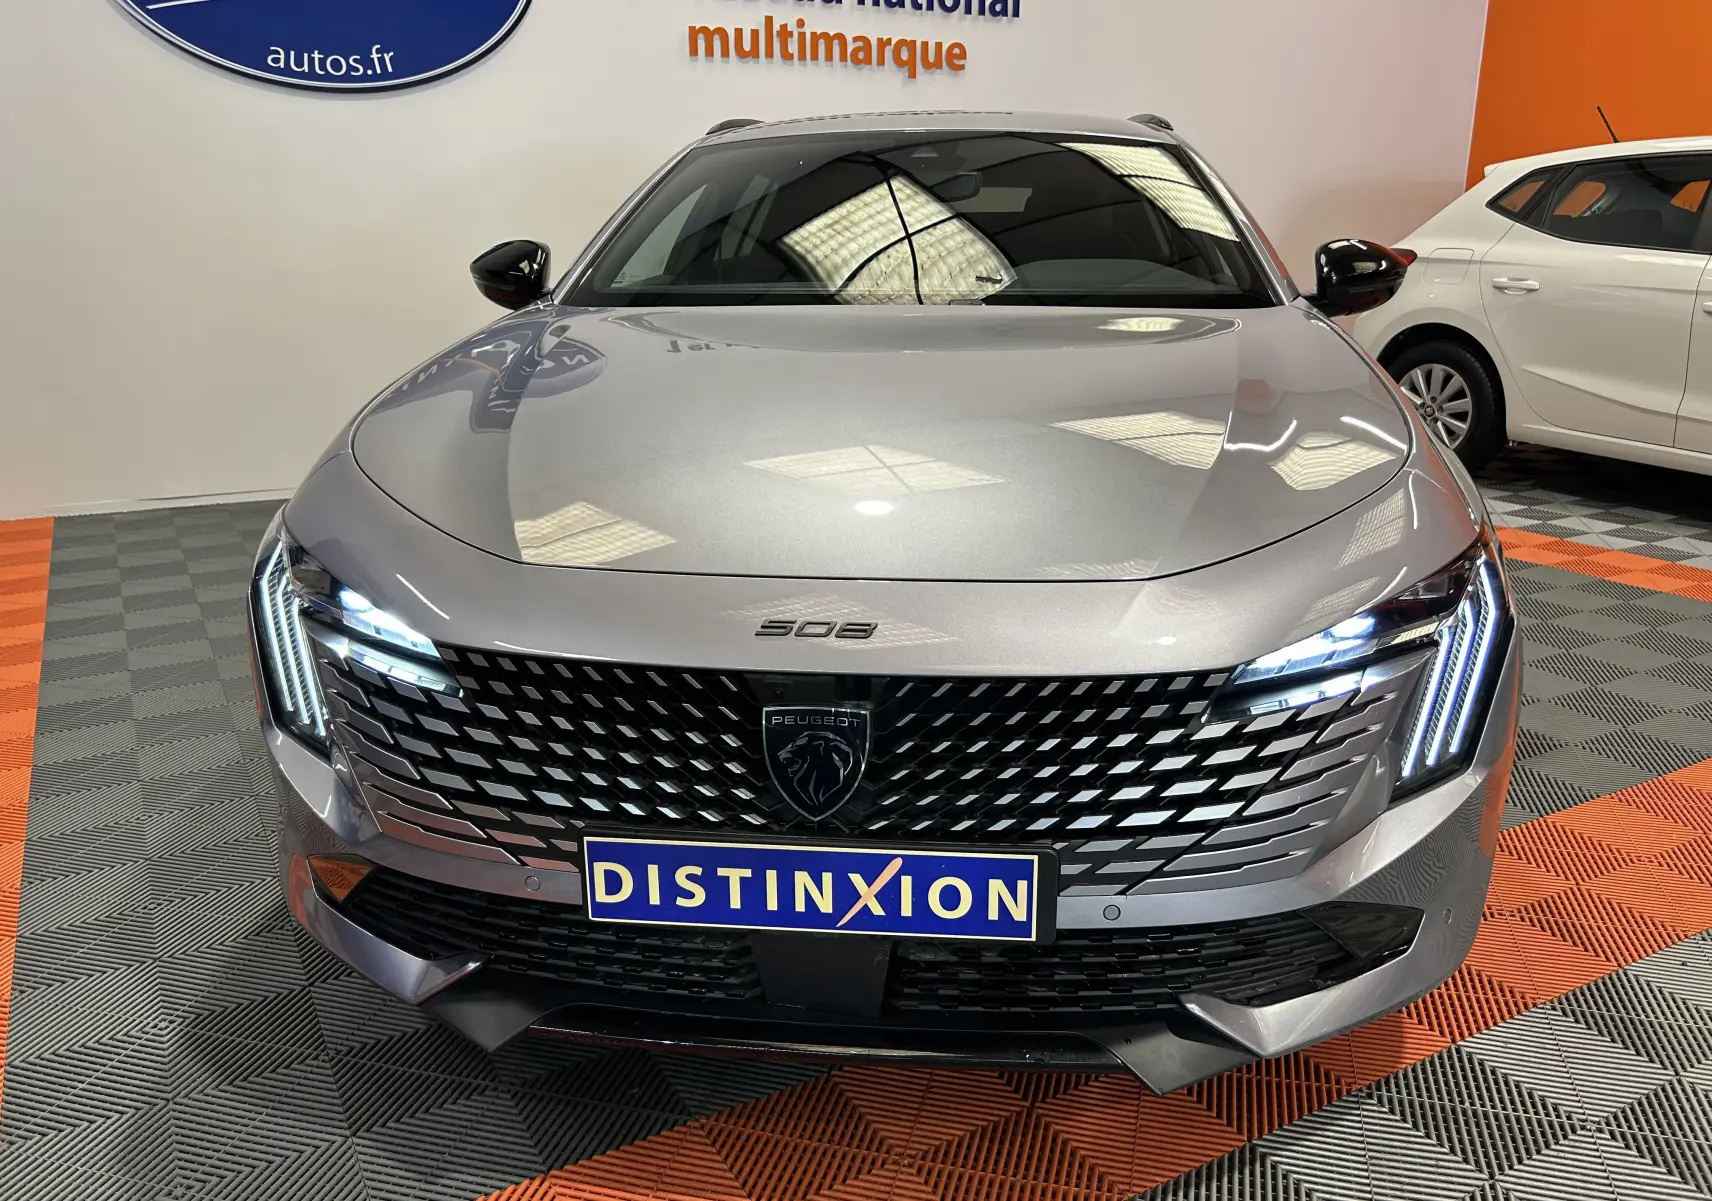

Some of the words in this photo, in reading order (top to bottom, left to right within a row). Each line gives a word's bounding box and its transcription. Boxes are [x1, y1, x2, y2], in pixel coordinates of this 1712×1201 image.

[266, 44, 394, 76] autos.fr
[688, 15, 967, 79] multimarque
[754, 618, 878, 639] 508
[771, 715, 861, 727] PEUGEOT
[593, 857, 1028, 927] DISTINXION
